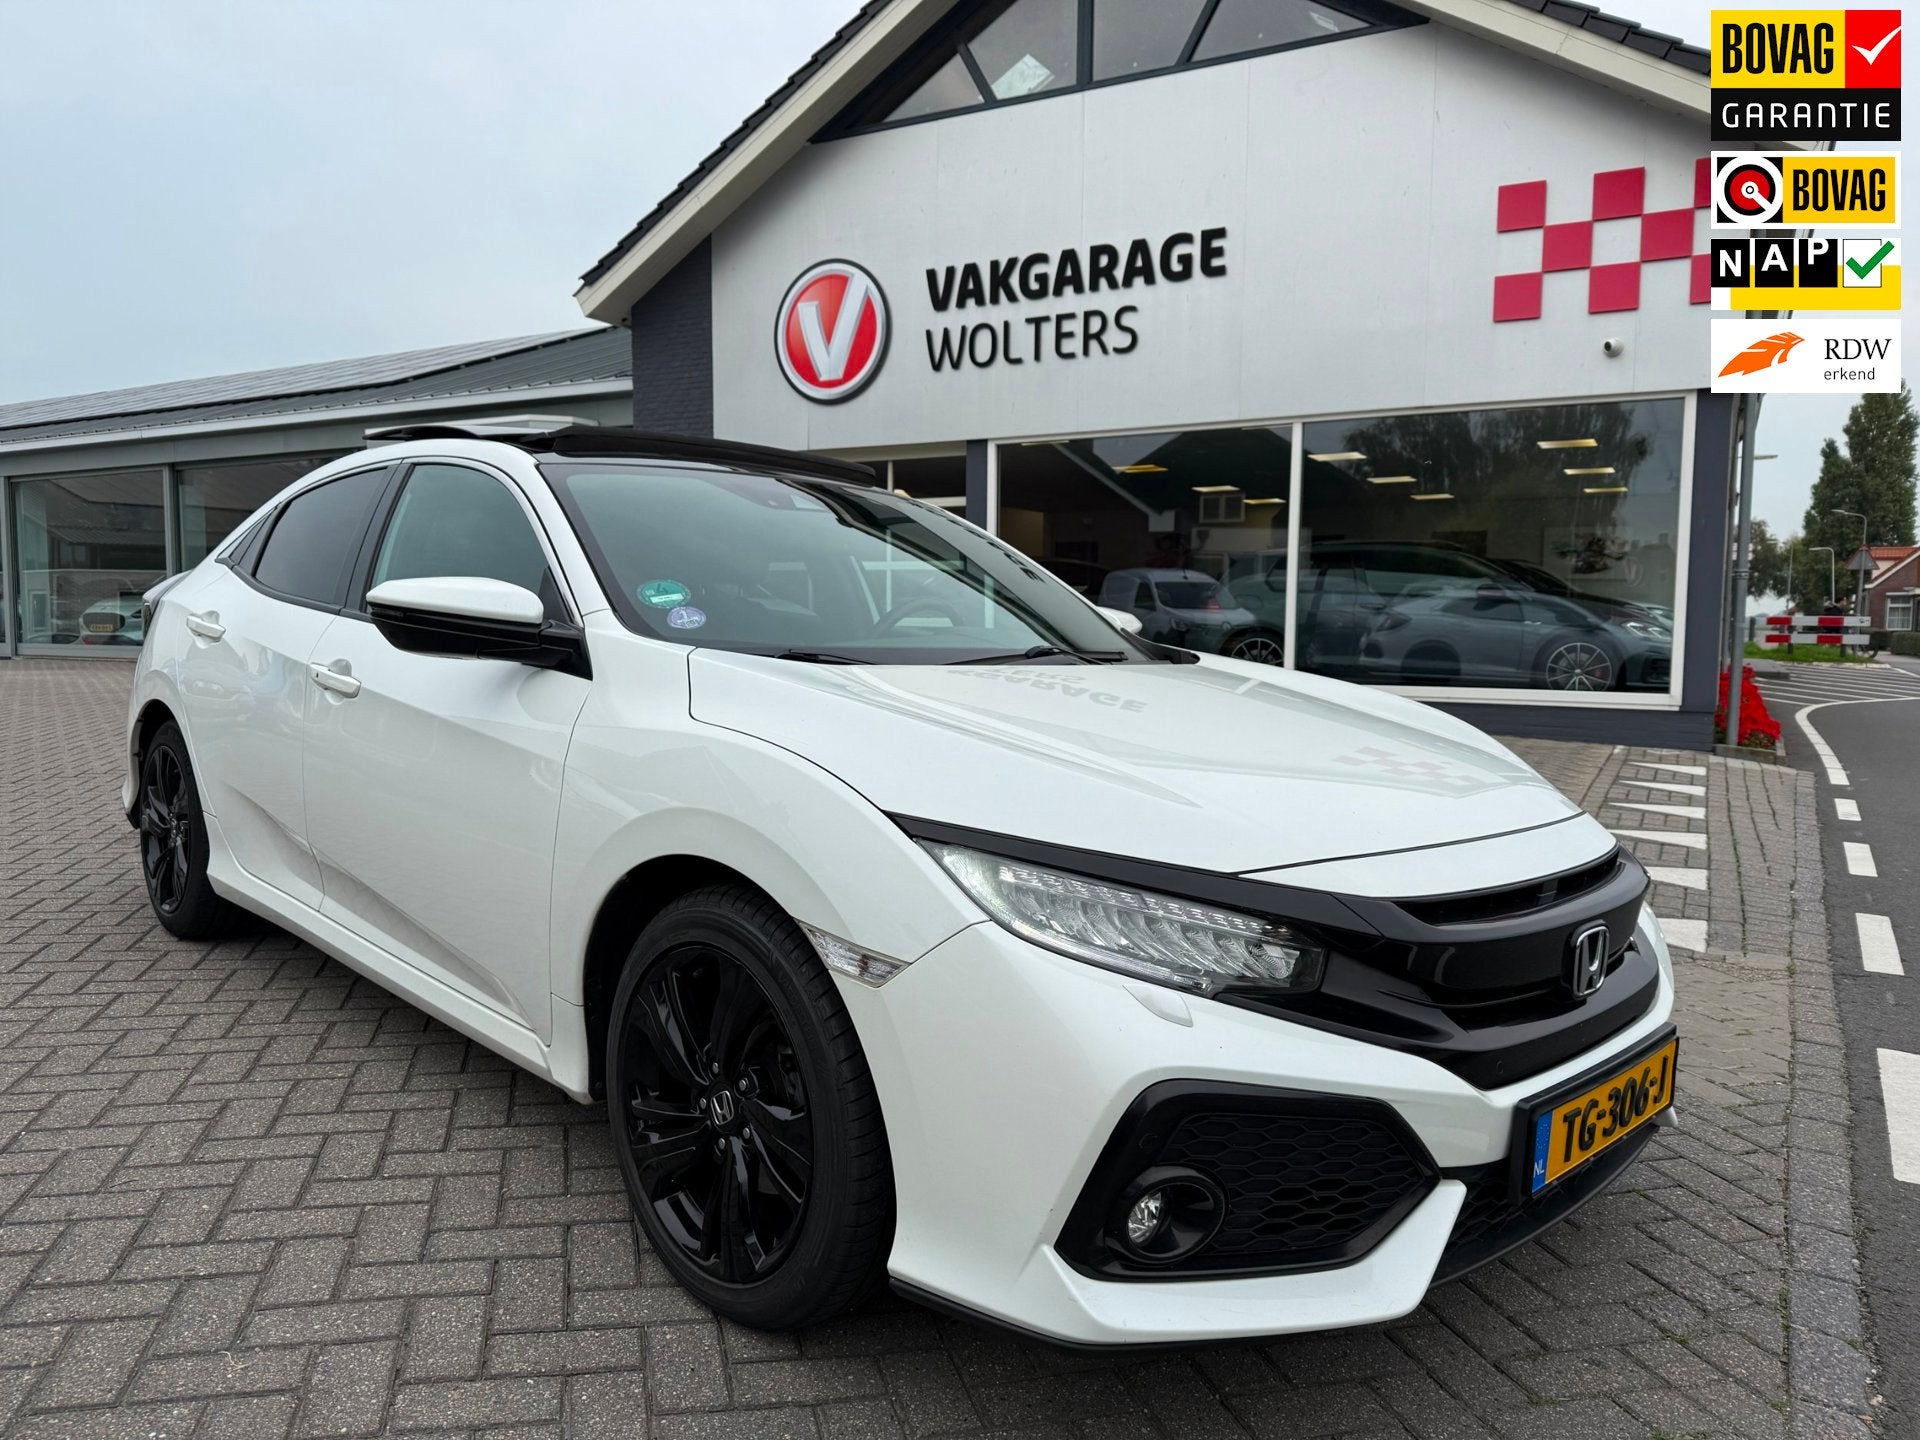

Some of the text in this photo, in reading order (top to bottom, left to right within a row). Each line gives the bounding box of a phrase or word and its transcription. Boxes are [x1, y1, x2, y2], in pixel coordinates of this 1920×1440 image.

[925, 226, 1228, 312] VAKGARAGE
[925, 305, 1139, 373] WOLTERS
[1563, 1055, 1668, 1163] TG-306-J
[1533, 1160, 1545, 1178] NL
